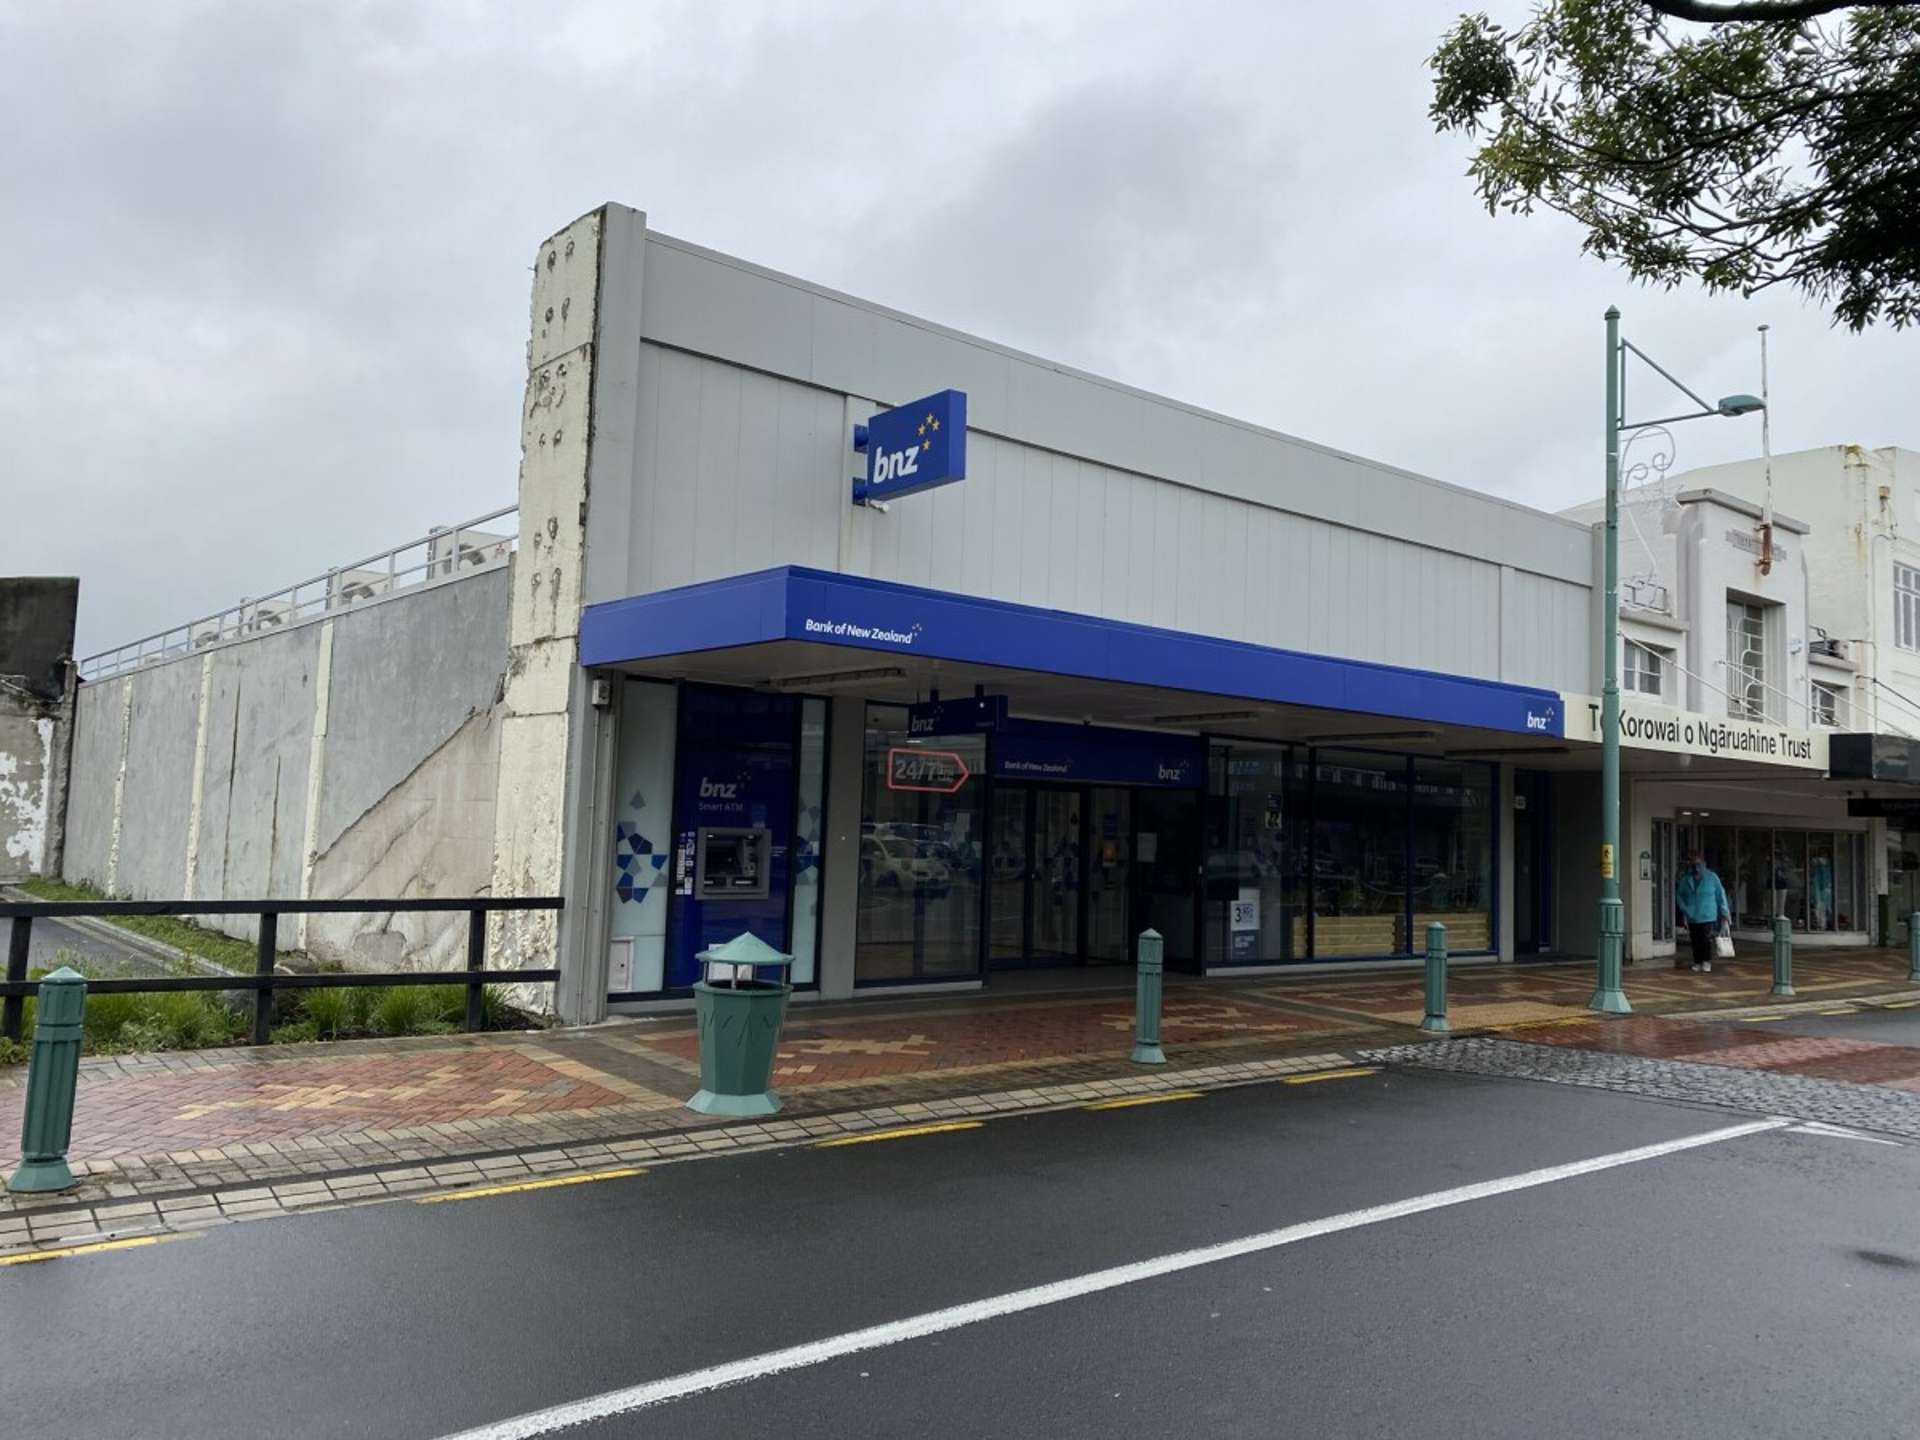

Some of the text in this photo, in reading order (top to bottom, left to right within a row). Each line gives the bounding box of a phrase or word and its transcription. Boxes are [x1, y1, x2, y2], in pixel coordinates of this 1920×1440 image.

[872, 446, 919, 484] bnz
[805, 618, 913, 644] Bank of New Zealand
[911, 713, 935, 733] bnz
[1527, 711, 1547, 731] bnz
[1588, 703, 1604, 732] T
[1685, 725, 1694, 744] o
[1698, 720, 1776, 755] Ngāruahine
[1779, 732, 1811, 759] Trust
[895, 758, 937, 782] 24/7
[1158, 763, 1180, 781] bnz
[698, 776, 737, 799] bnz
[698, 802, 744, 812] Smart ATM
